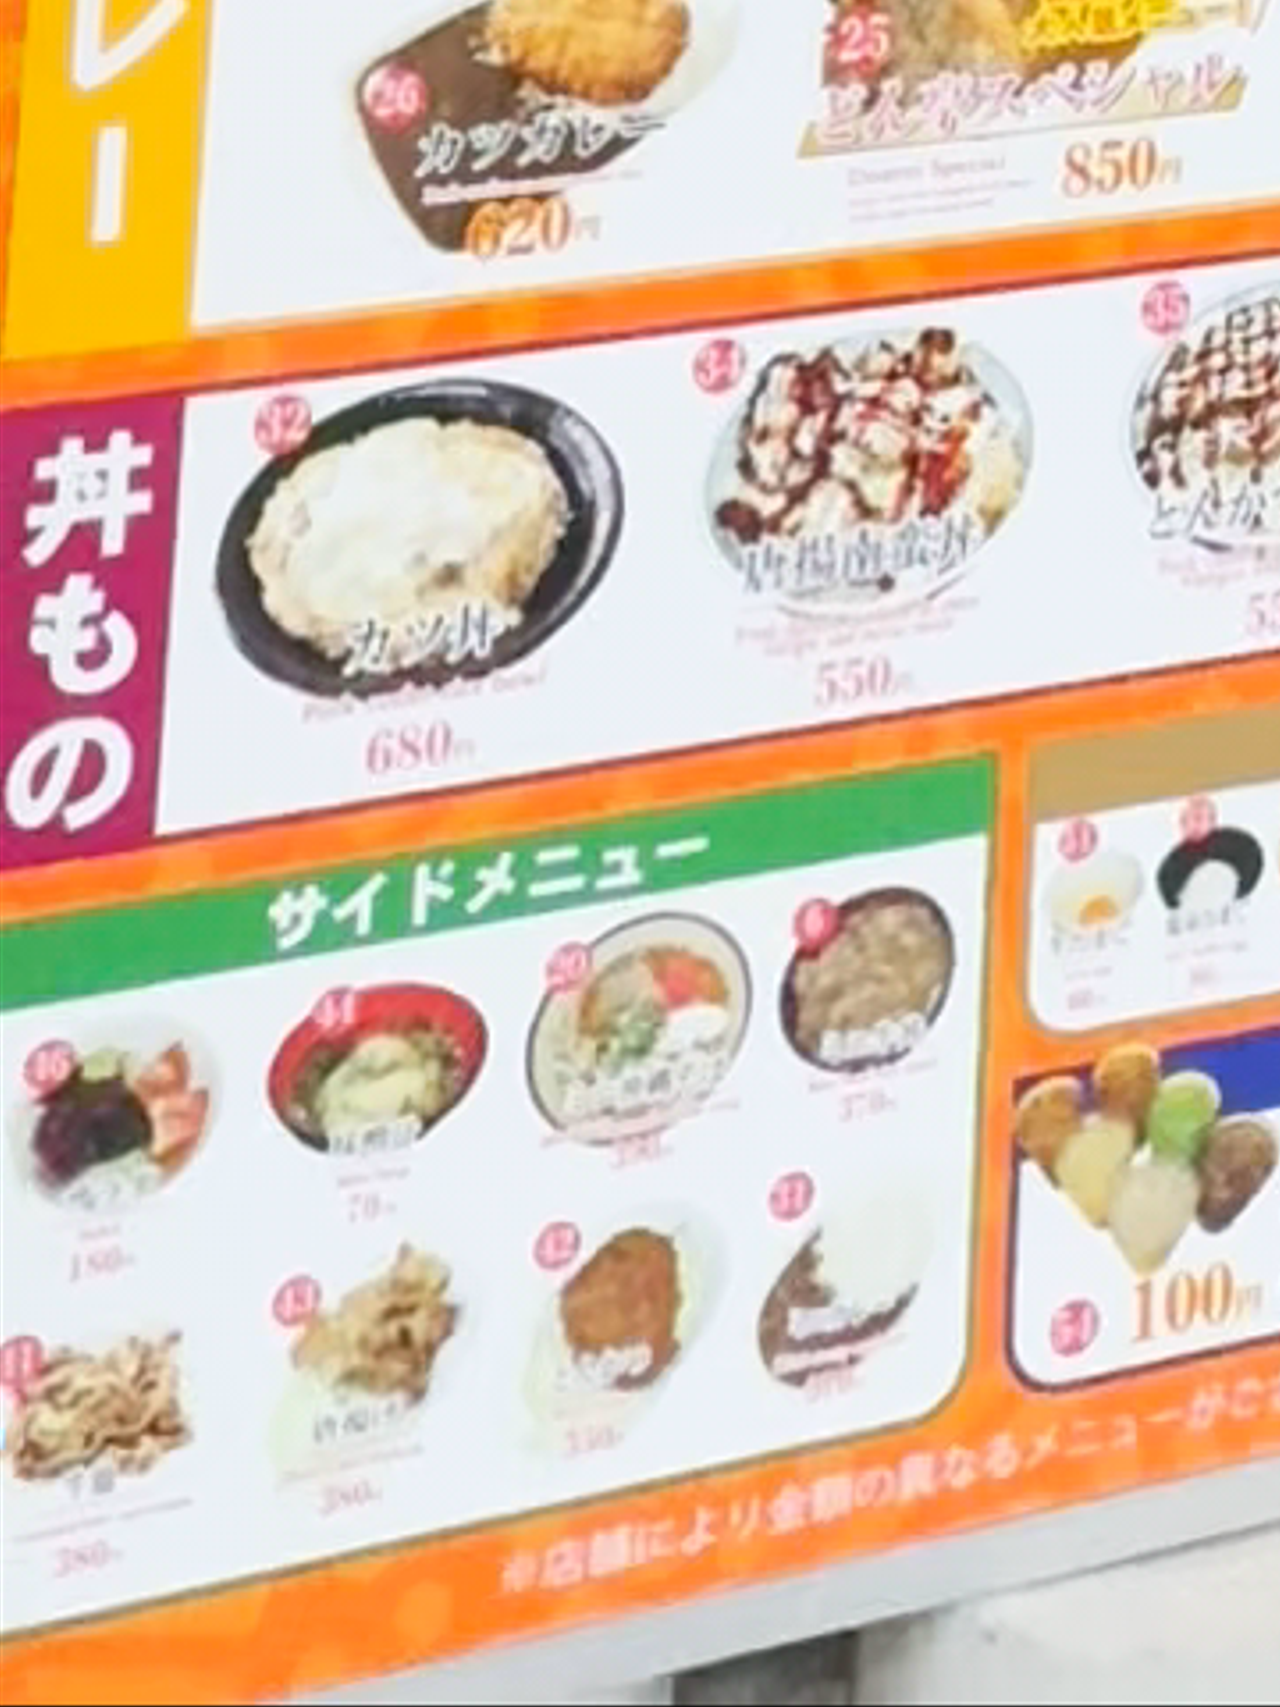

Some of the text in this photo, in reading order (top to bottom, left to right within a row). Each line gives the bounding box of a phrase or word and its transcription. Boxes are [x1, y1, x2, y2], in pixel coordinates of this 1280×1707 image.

[413, 108, 667, 179] カツカレー
[4, 429, 153, 833] 丼もの
[341, 604, 501, 680] カツ丼
[265, 833, 711, 951] サイドメニュー
